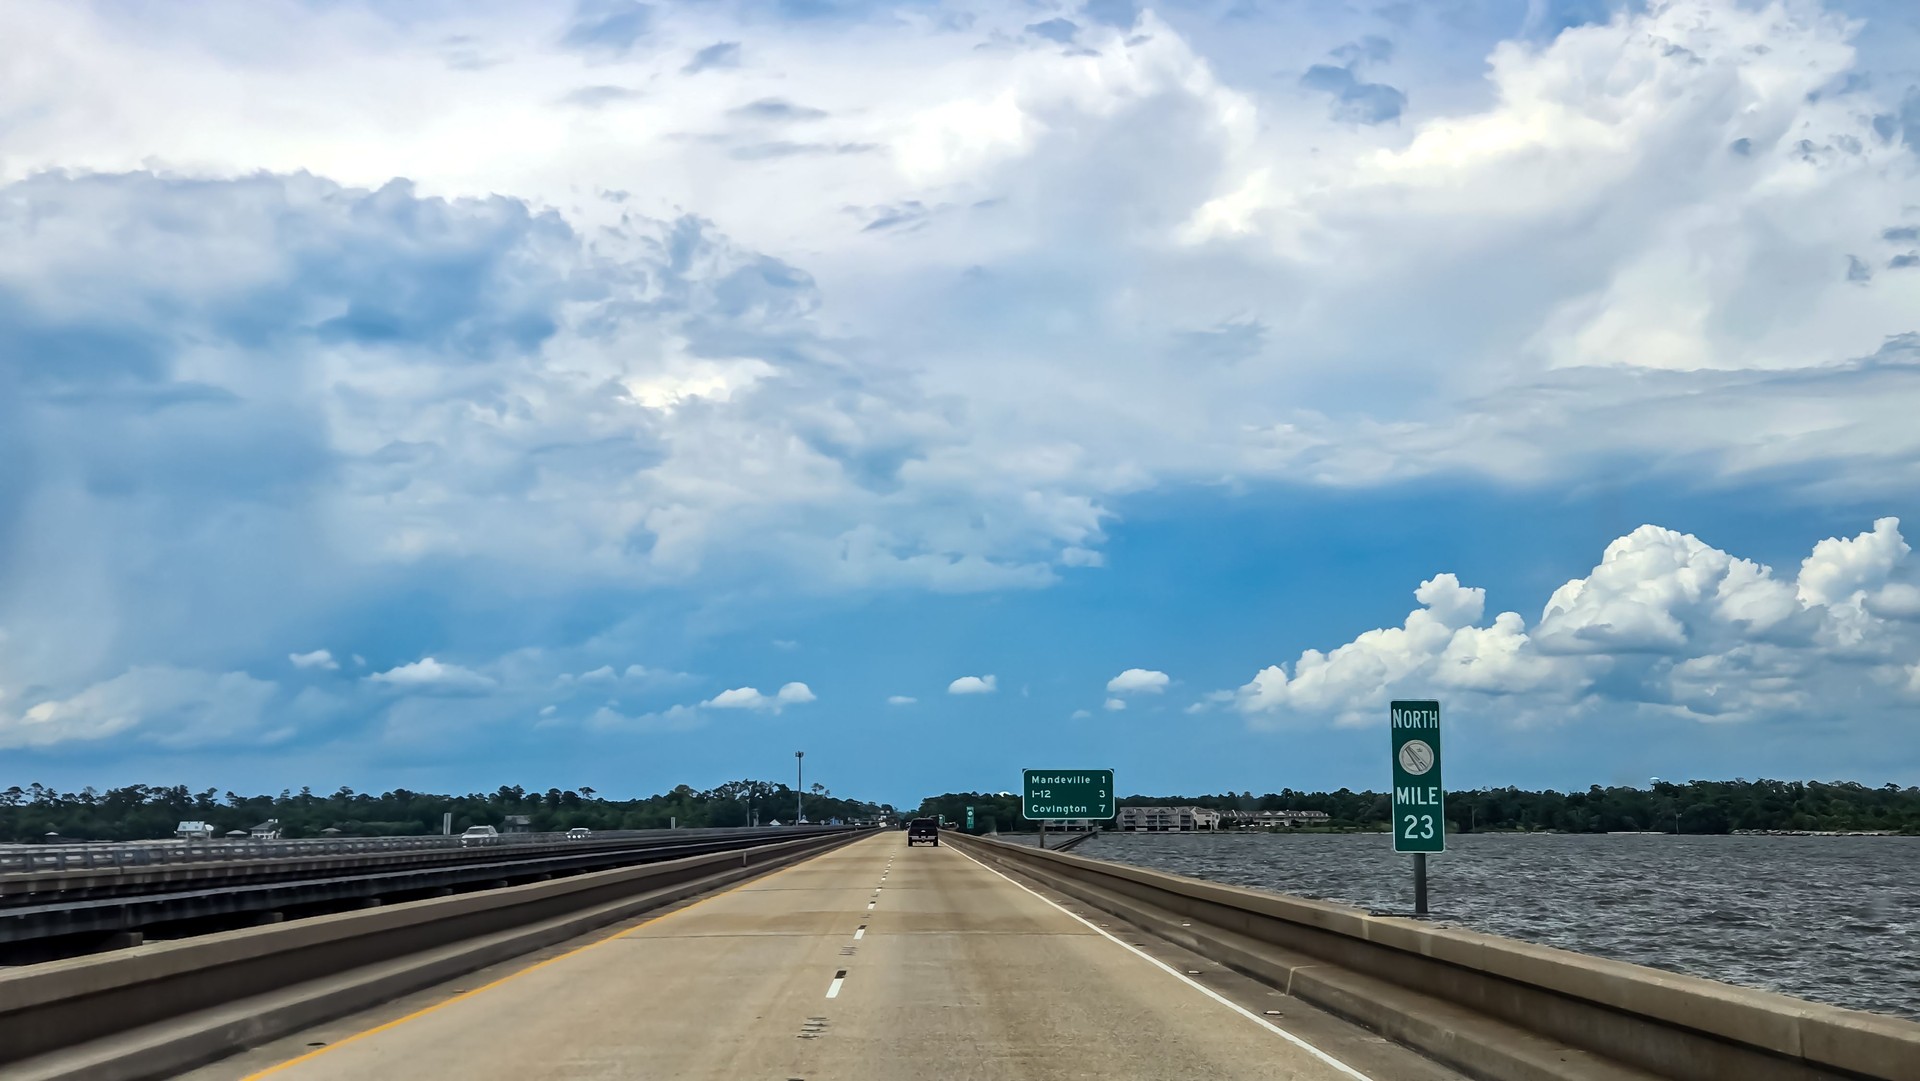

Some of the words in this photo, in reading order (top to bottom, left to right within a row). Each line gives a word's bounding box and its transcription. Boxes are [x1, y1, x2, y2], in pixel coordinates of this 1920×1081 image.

[1392, 708, 1438, 729] NORTH
[1031, 776, 1091, 784] Mandeville
[1101, 776, 1106, 784] 1
[1031, 790, 1051, 798] I-12
[1099, 790, 1106, 798] 3
[1397, 786, 1439, 805] MILE
[1032, 804, 1087, 815] Covington
[1098, 804, 1106, 813] 7
[1404, 814, 1434, 839] 23
